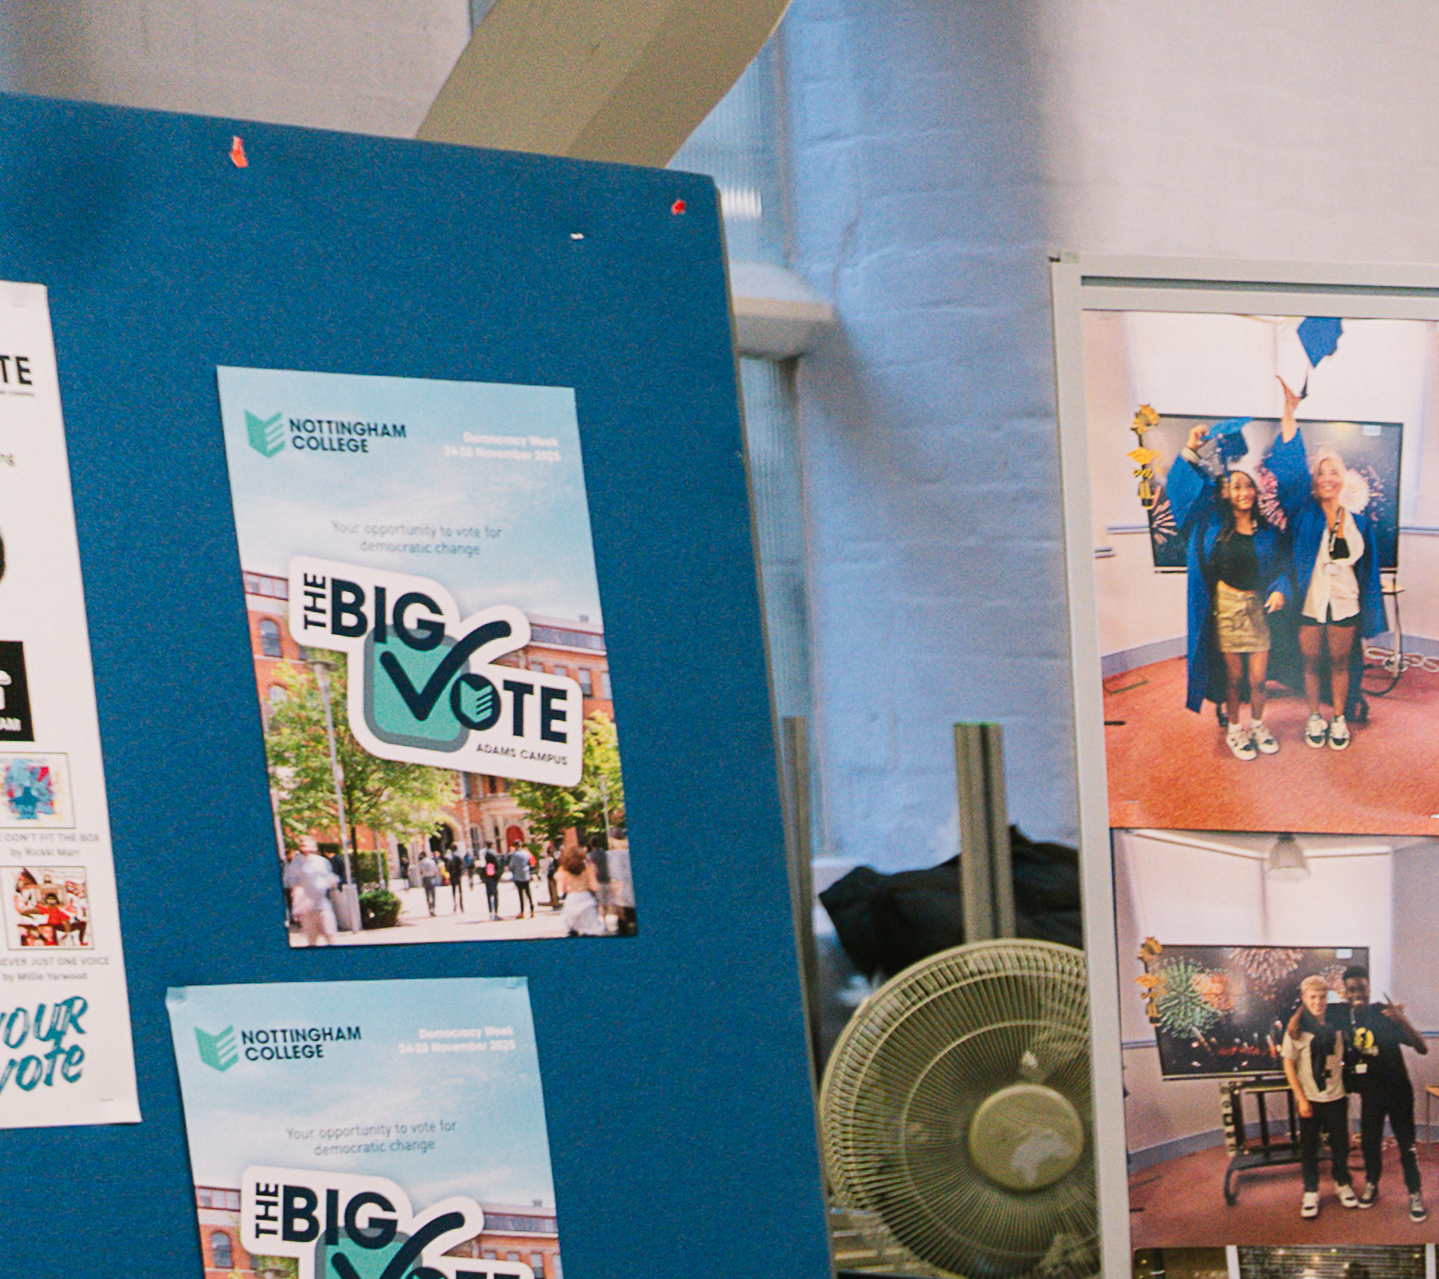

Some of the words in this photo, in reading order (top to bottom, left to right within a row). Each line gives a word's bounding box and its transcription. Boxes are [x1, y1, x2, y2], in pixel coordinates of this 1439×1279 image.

[289, 418, 407, 438] NOTTINGHAM
[292, 435, 369, 453] COLLEGE
[332, 520, 359, 533] Your
[364, 522, 436, 538] opportunity
[440, 523, 452, 537] to
[456, 526, 481, 538] vote
[484, 525, 502, 538] for
[361, 541, 431, 554] democratic
[435, 542, 480, 557] change
[304, 573, 327, 630] THE
[331, 578, 445, 651] BIG
[477, 743, 516, 758] ADAMS
[520, 749, 567, 765] CAMPUS
[58, 957, 77, 965] ONE
[82, 957, 109, 965] VOICE
[0, 996, 87, 1049] OUR
[242, 1026, 362, 1045] NOTTINGHAM
[245, 1044, 324, 1061] COLLEGE
[286, 1127, 314, 1140] Your
[319, 1123, 392, 1139] opportunity
[395, 1122, 407, 1134] to
[411, 1122, 437, 1134] vote
[440, 1119, 457, 1132] for
[314, 1143, 386, 1157] democratic
[390, 1138, 435, 1154] change
[255, 1182, 279, 1239] THE
[282, 1184, 398, 1250] BIG
